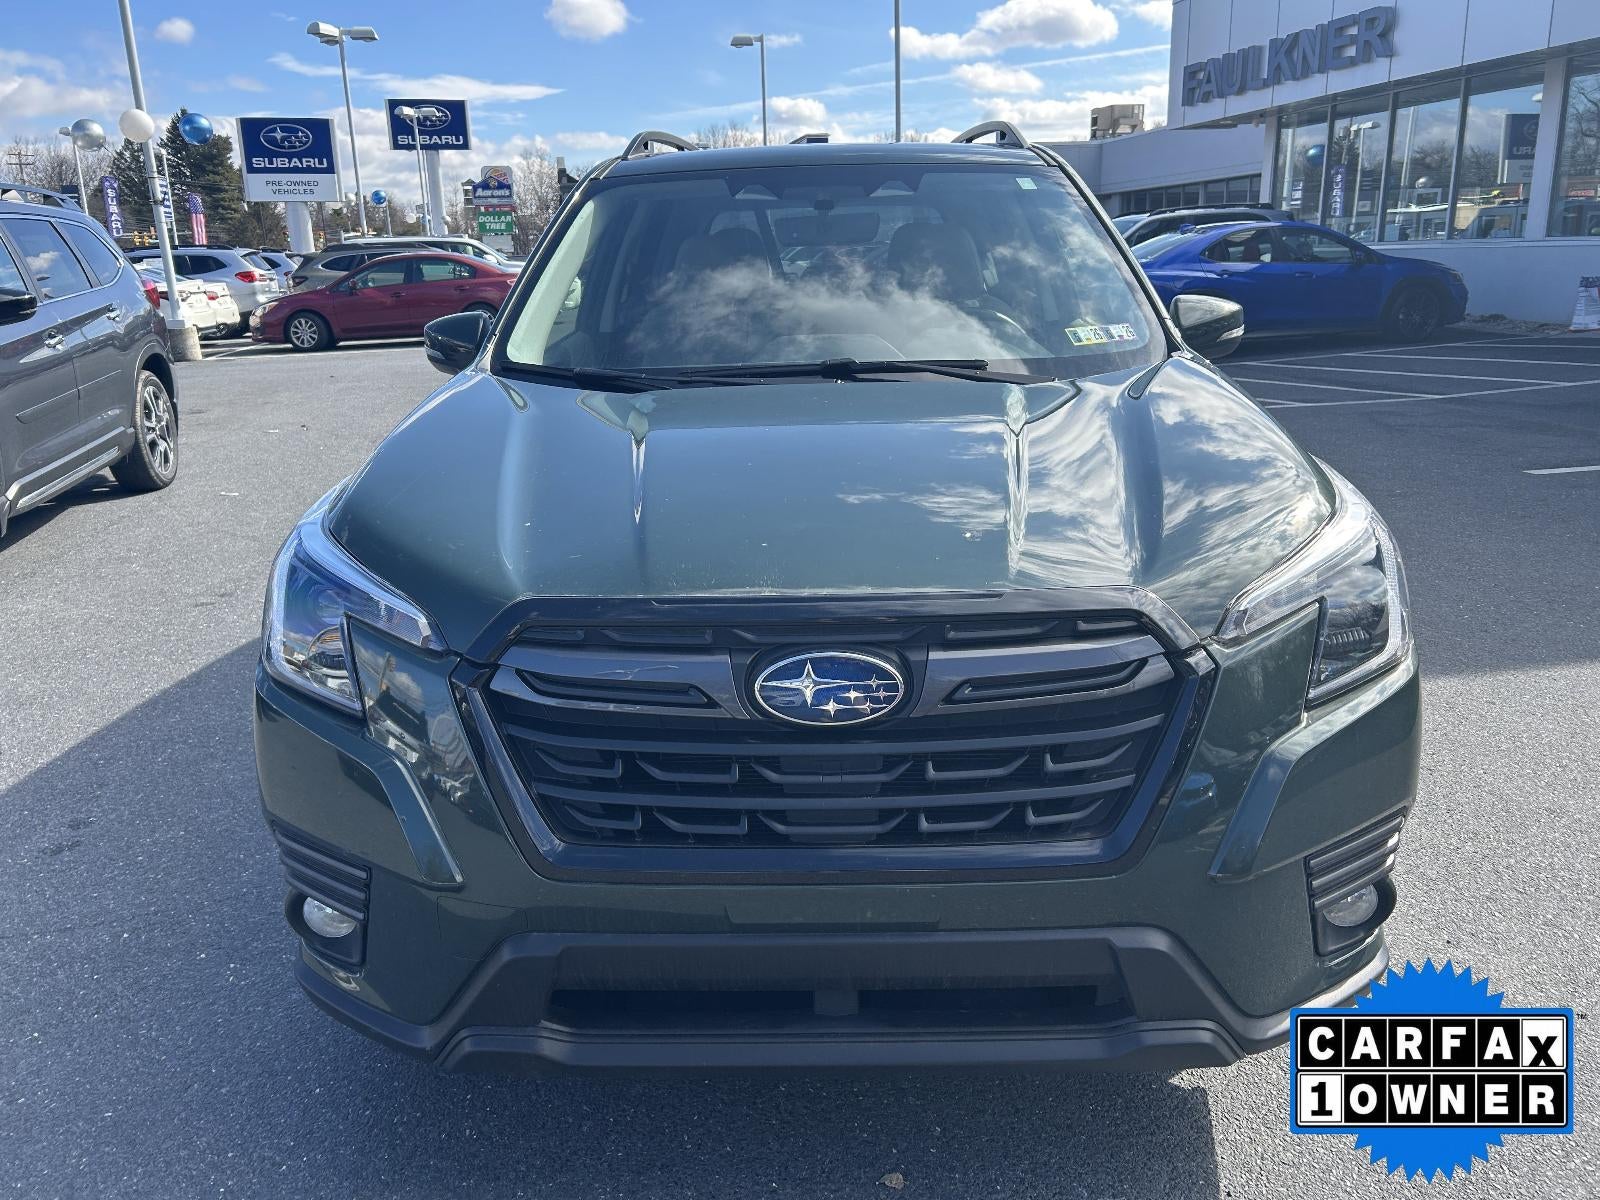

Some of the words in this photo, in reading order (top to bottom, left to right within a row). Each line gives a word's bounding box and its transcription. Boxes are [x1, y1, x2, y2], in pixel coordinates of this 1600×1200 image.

[1182, 6, 1394, 107] FAULKNER
[397, 135, 464, 145] SUBARU
[252, 157, 328, 168] SUBARU
[475, 187, 511, 198] Aaron's
[106, 188, 123, 237] SUBARU
[478, 215, 512, 223] DOLLAR
[485, 222, 507, 230] TREE
